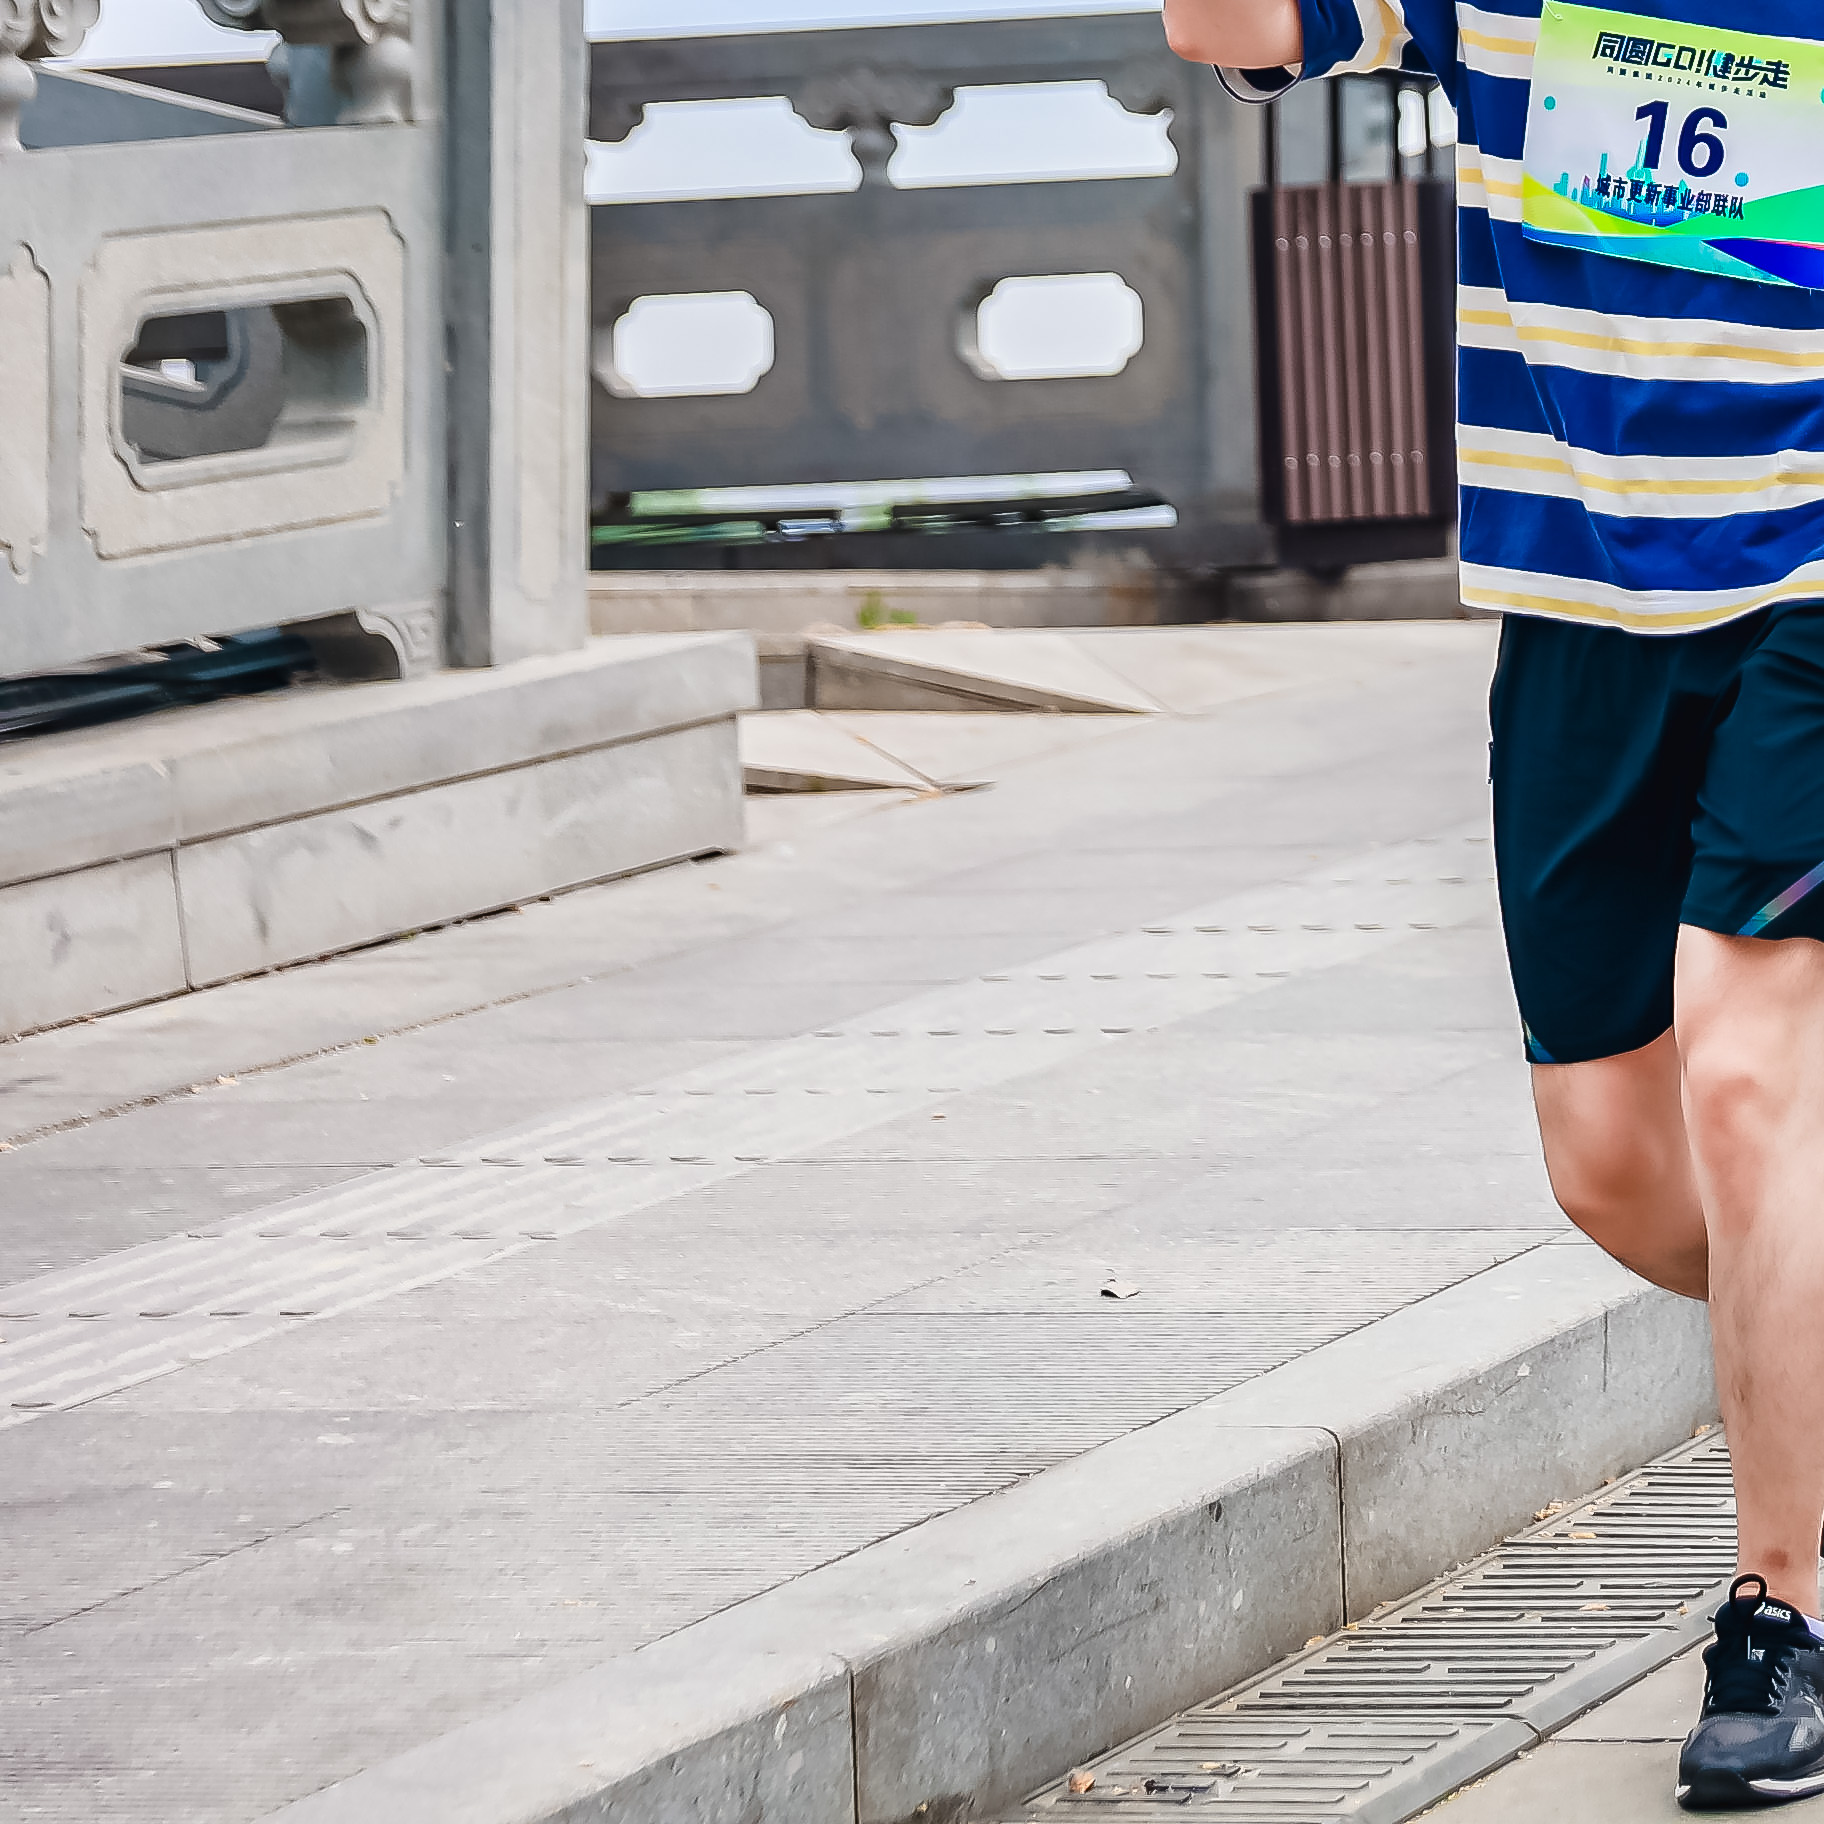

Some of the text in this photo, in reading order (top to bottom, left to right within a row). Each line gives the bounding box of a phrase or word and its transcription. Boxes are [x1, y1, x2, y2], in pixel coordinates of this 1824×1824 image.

[1591, 31, 1791, 90] 同圆GO!健步走
[1634, 99, 1729, 178] 16
[1595, 172, 1744, 221] 城市更新事业部联队
[1763, 1604, 1792, 1622] asics
